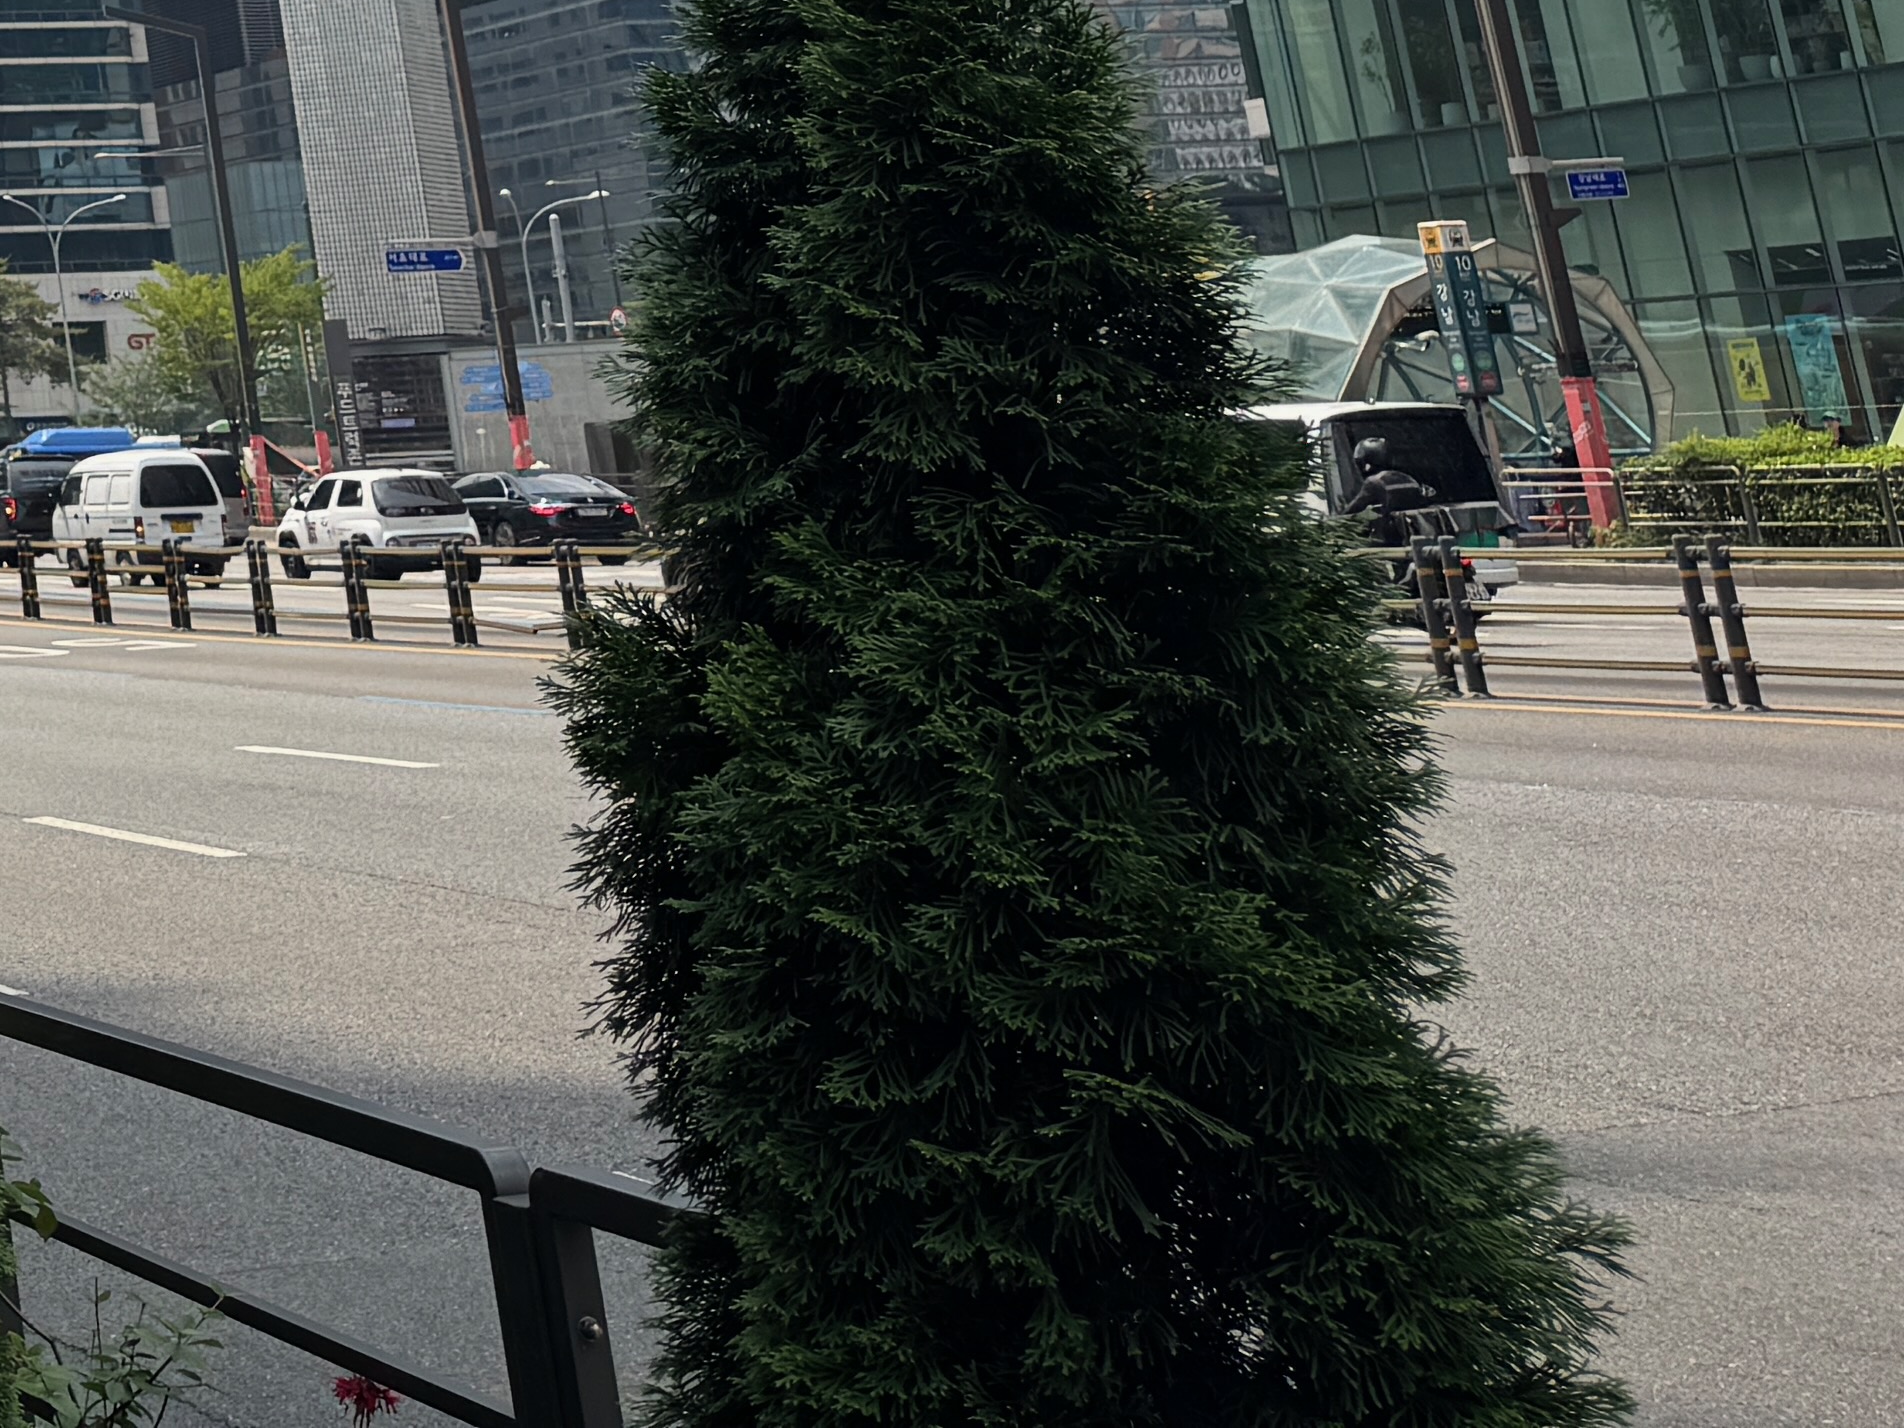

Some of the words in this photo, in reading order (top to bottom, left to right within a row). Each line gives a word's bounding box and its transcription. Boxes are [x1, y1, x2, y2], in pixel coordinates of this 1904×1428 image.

[1455, 255, 1471, 271] 10
[1436, 283, 1454, 326] 강남
[1463, 290, 1480, 328] 강남
